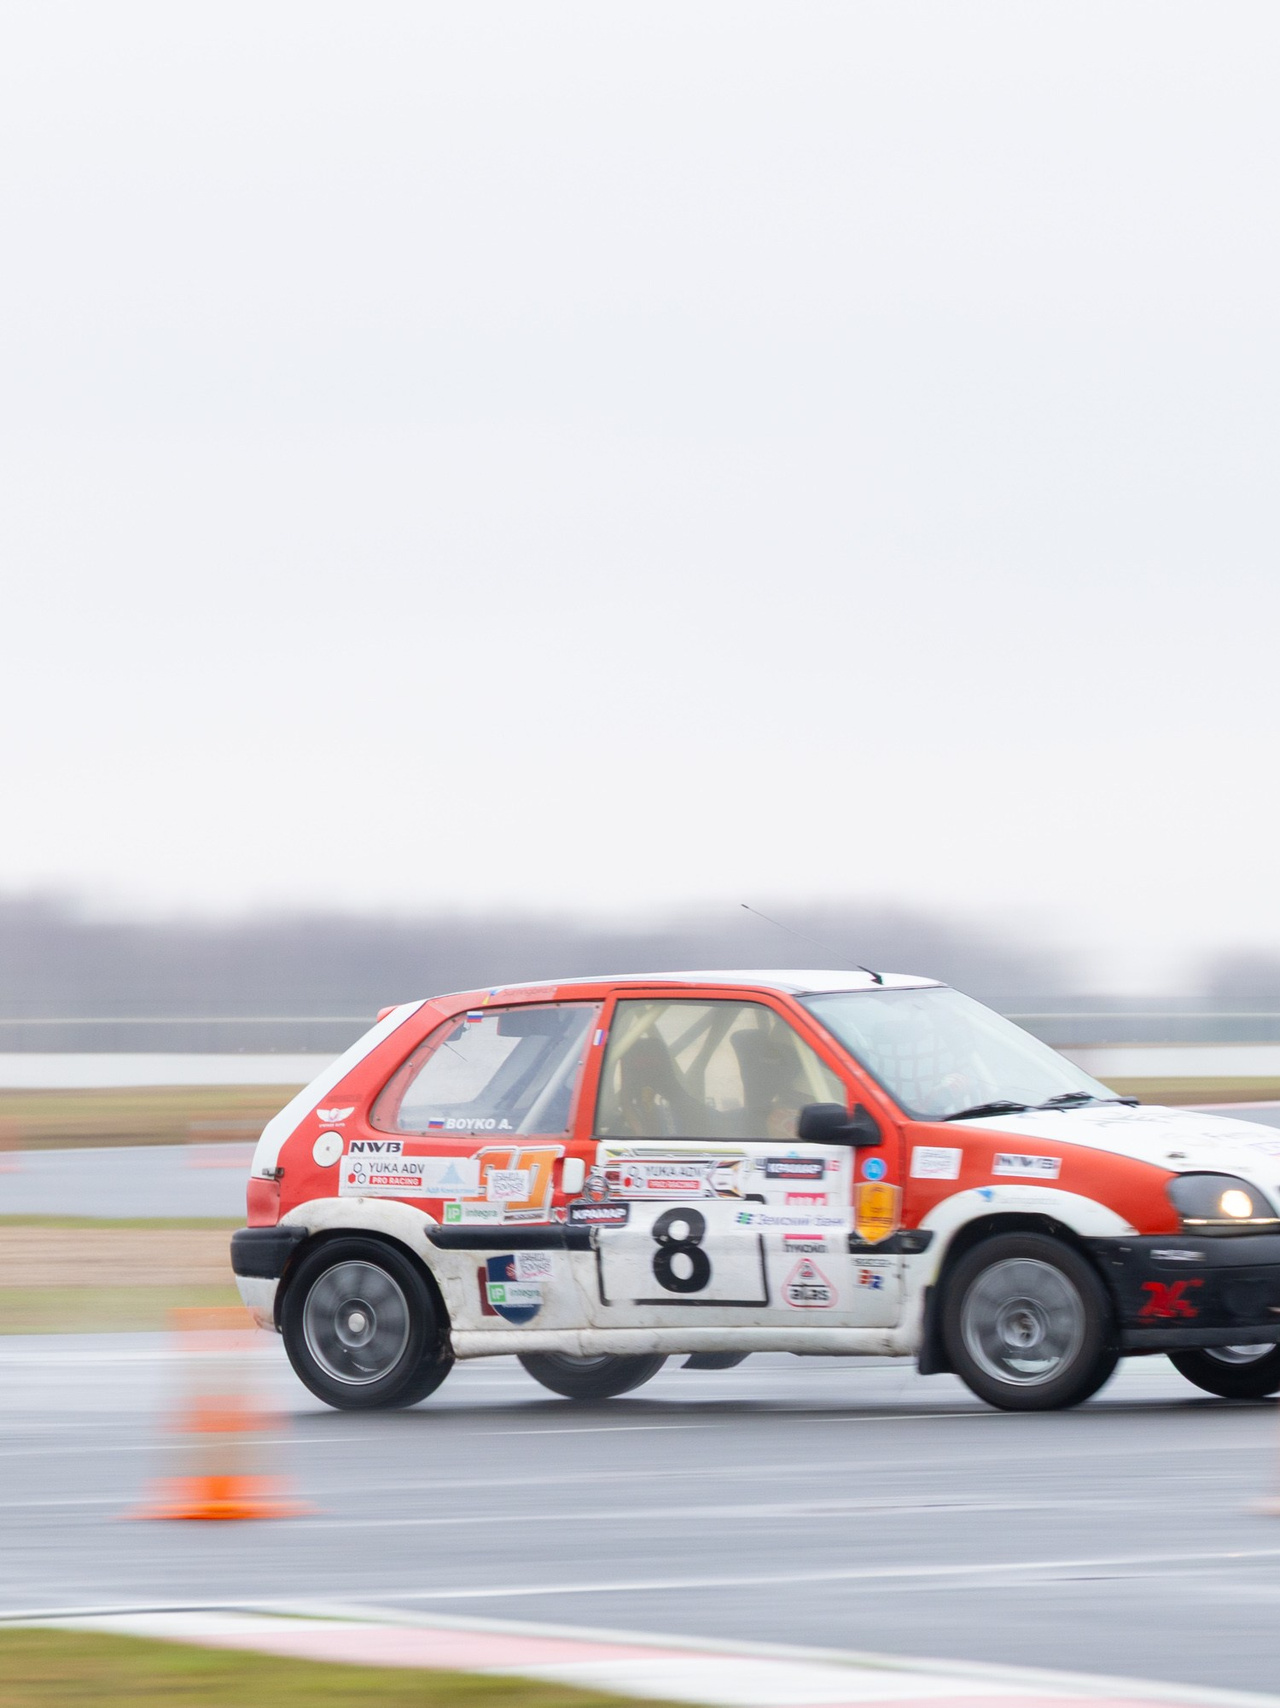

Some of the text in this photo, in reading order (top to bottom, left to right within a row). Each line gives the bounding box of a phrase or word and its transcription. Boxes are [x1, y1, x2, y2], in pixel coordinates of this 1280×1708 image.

[446, 1118, 513, 1130] BOYKO A.
[350, 1142, 401, 1153] NWB
[369, 1162, 425, 1175] YUKA ADV
[372, 1176, 419, 1186] PRO RACING
[652, 1207, 711, 1293] 8
